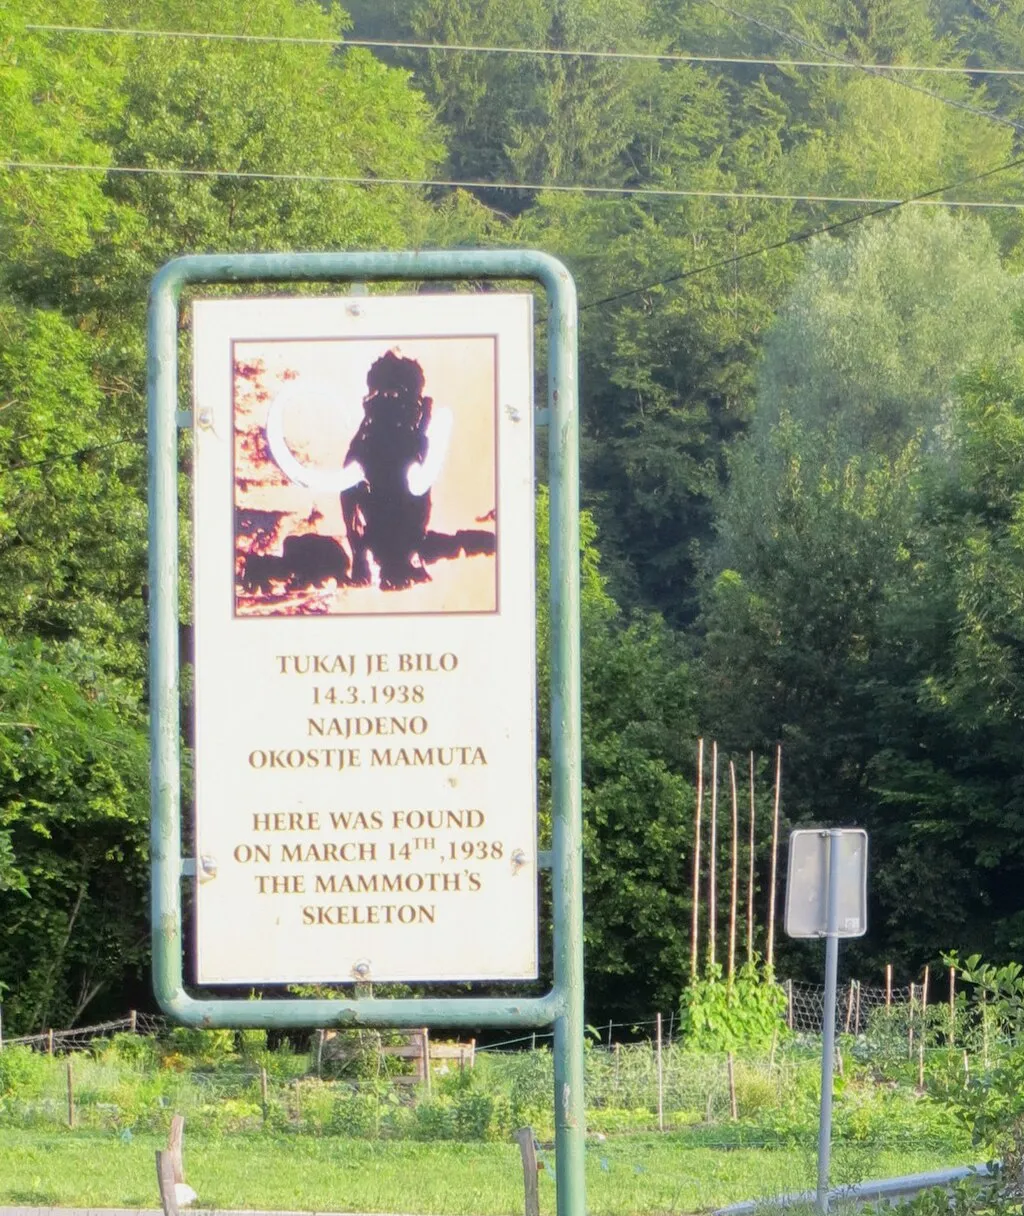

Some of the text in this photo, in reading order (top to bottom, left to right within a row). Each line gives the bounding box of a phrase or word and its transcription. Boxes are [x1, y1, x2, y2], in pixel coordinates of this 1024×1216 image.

[276, 653, 458, 676] TUKAJ JE BILO
[314, 685, 424, 704] 14.3.1938
[308, 716, 428, 739] NAJDENO
[249, 747, 488, 771] OKOSTJE MAMUTA
[253, 810, 485, 831] HERE WAS FOUND
[234, 845, 270, 863] ON
[282, 843, 376, 863] MARCH
[255, 869, 481, 894] THE MAMMOTH'S
[303, 905, 434, 925] SKELETON
